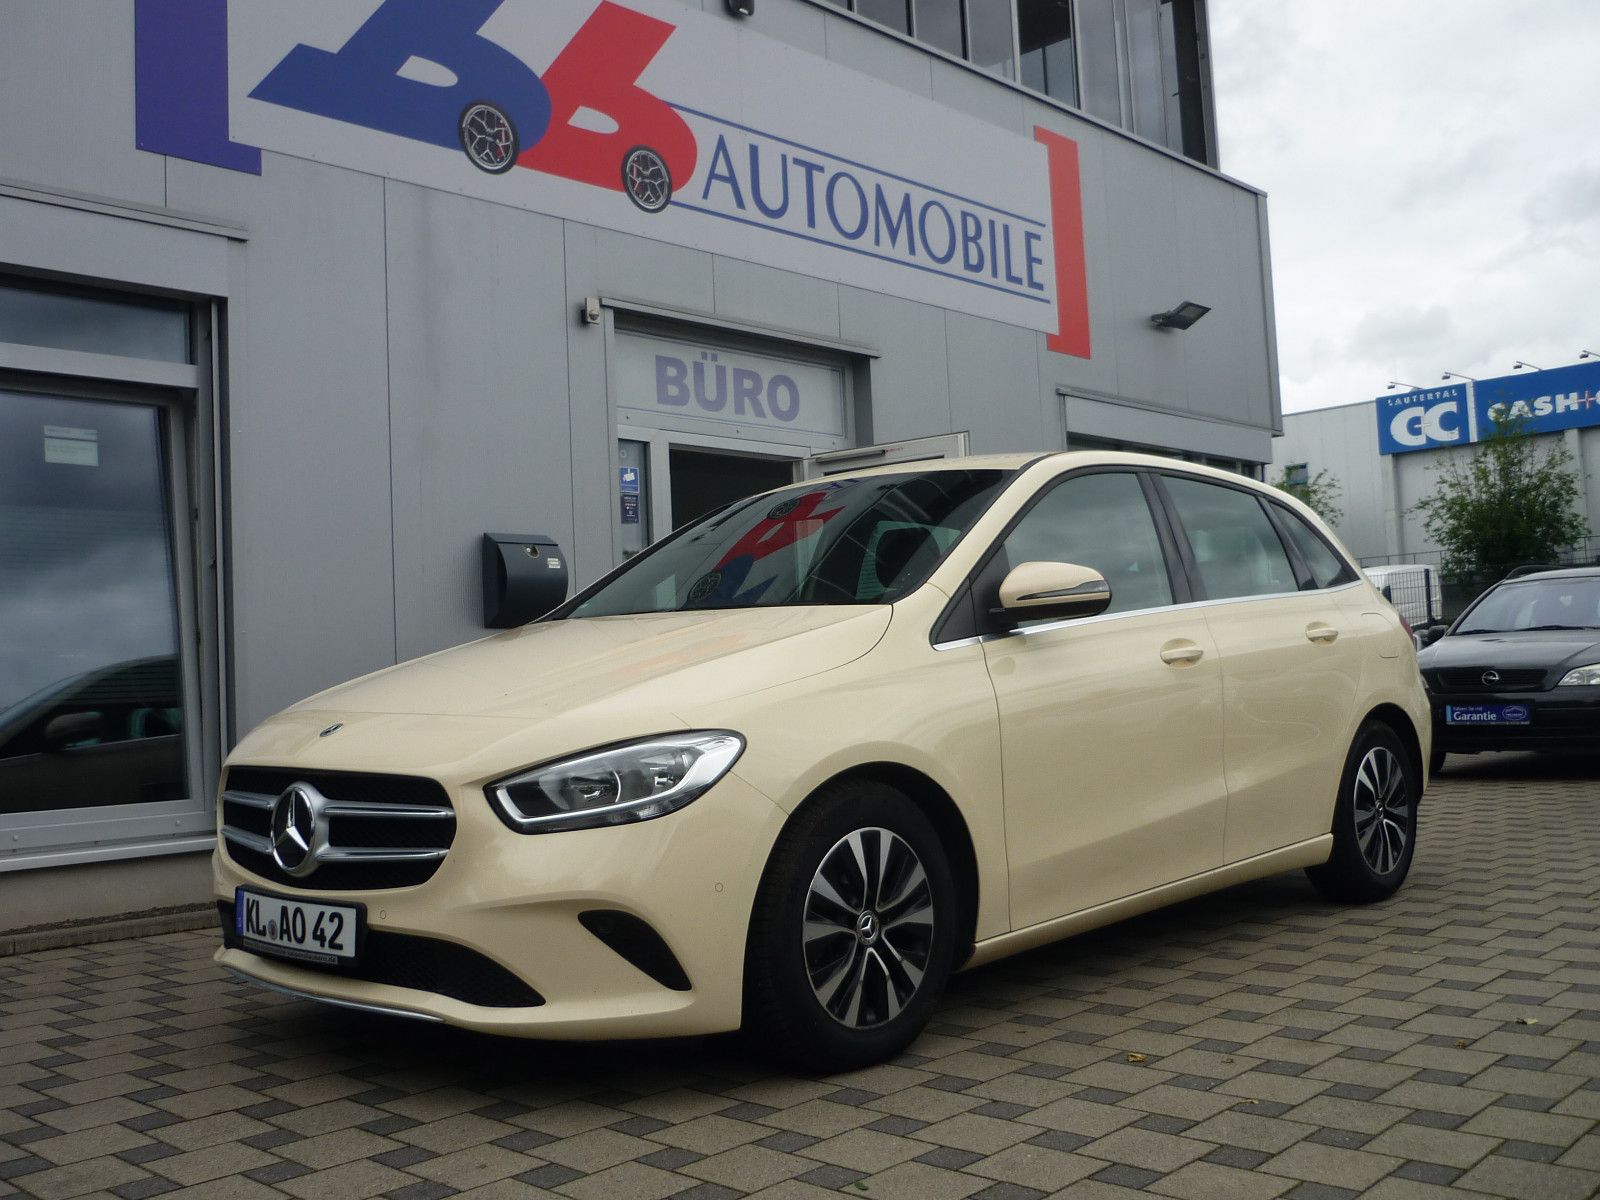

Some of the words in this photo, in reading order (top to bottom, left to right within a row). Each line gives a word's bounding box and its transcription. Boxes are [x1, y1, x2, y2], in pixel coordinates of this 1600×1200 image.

[702, 134, 1045, 291] AUTOMOBILE
[655, 351, 800, 422] BÜRO
[1387, 389, 1457, 407] LAUTERTAL
[1453, 711, 1497, 721] Garantie
[246, 897, 267, 937] KL
[279, 905, 306, 944] AO
[312, 910, 344, 951] 42
